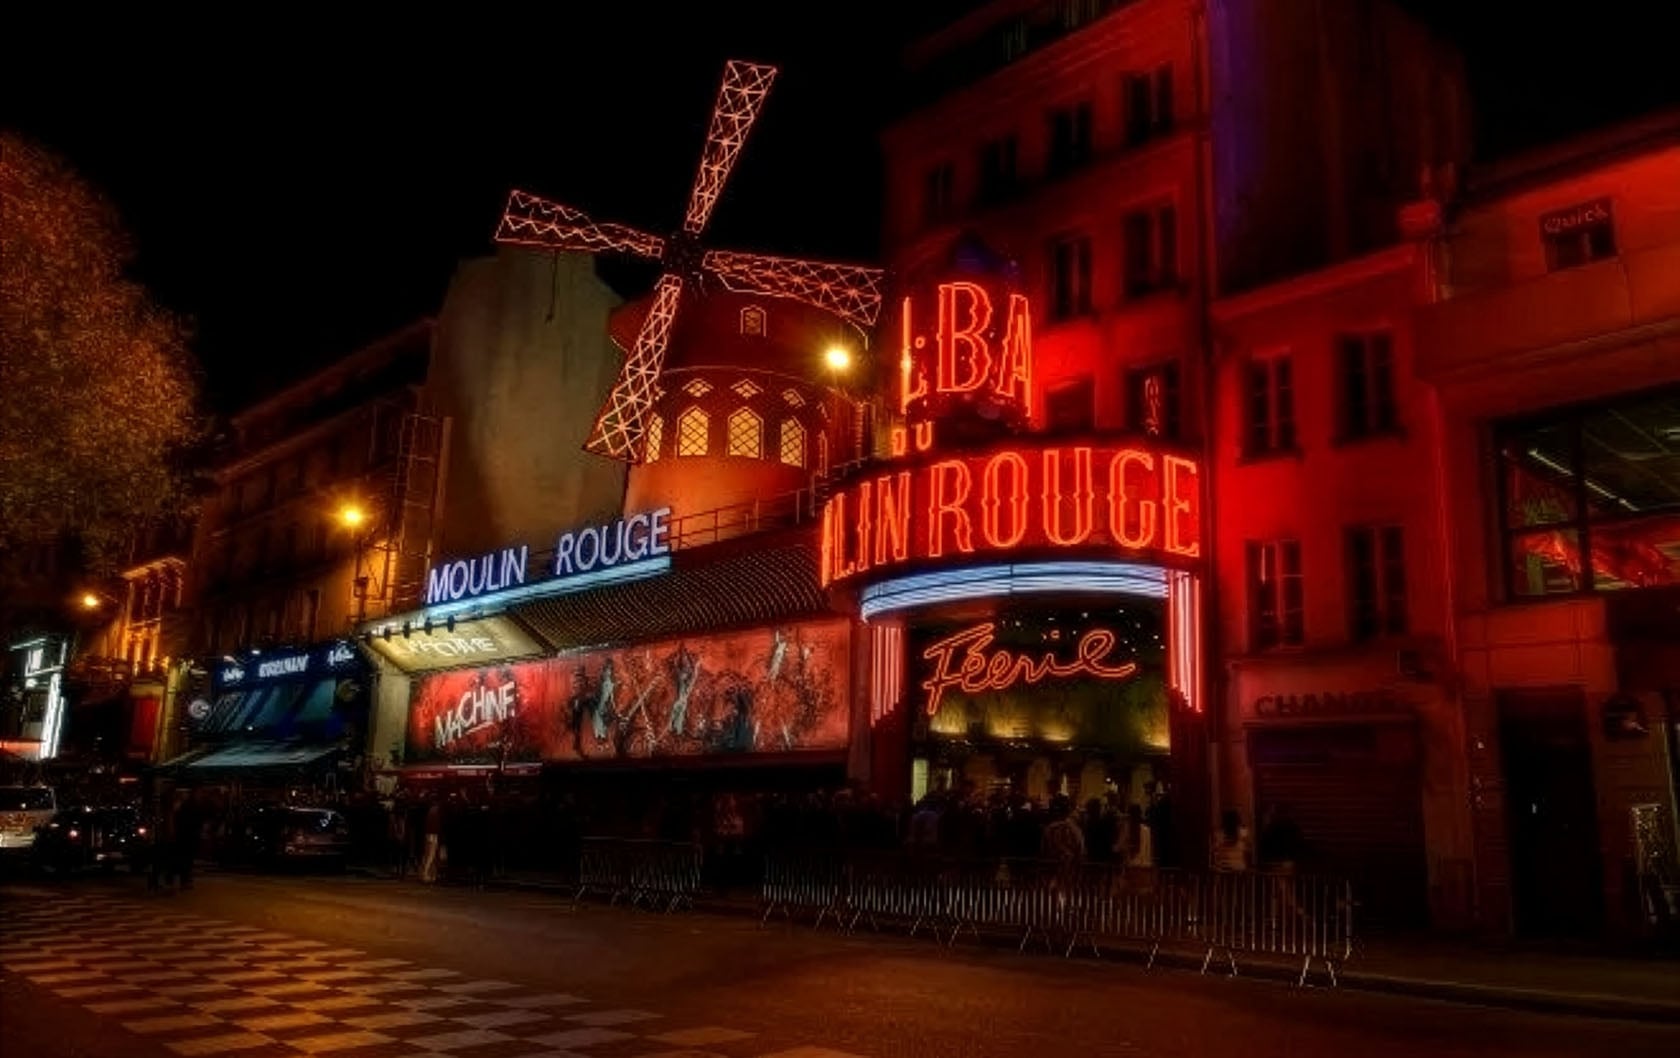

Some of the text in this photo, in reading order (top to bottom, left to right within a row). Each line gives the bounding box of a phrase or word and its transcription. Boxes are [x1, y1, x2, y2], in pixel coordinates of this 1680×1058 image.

[426, 507, 672, 605] MOULIN ROUGE
[820, 446, 1201, 590] LIN ROUGE
